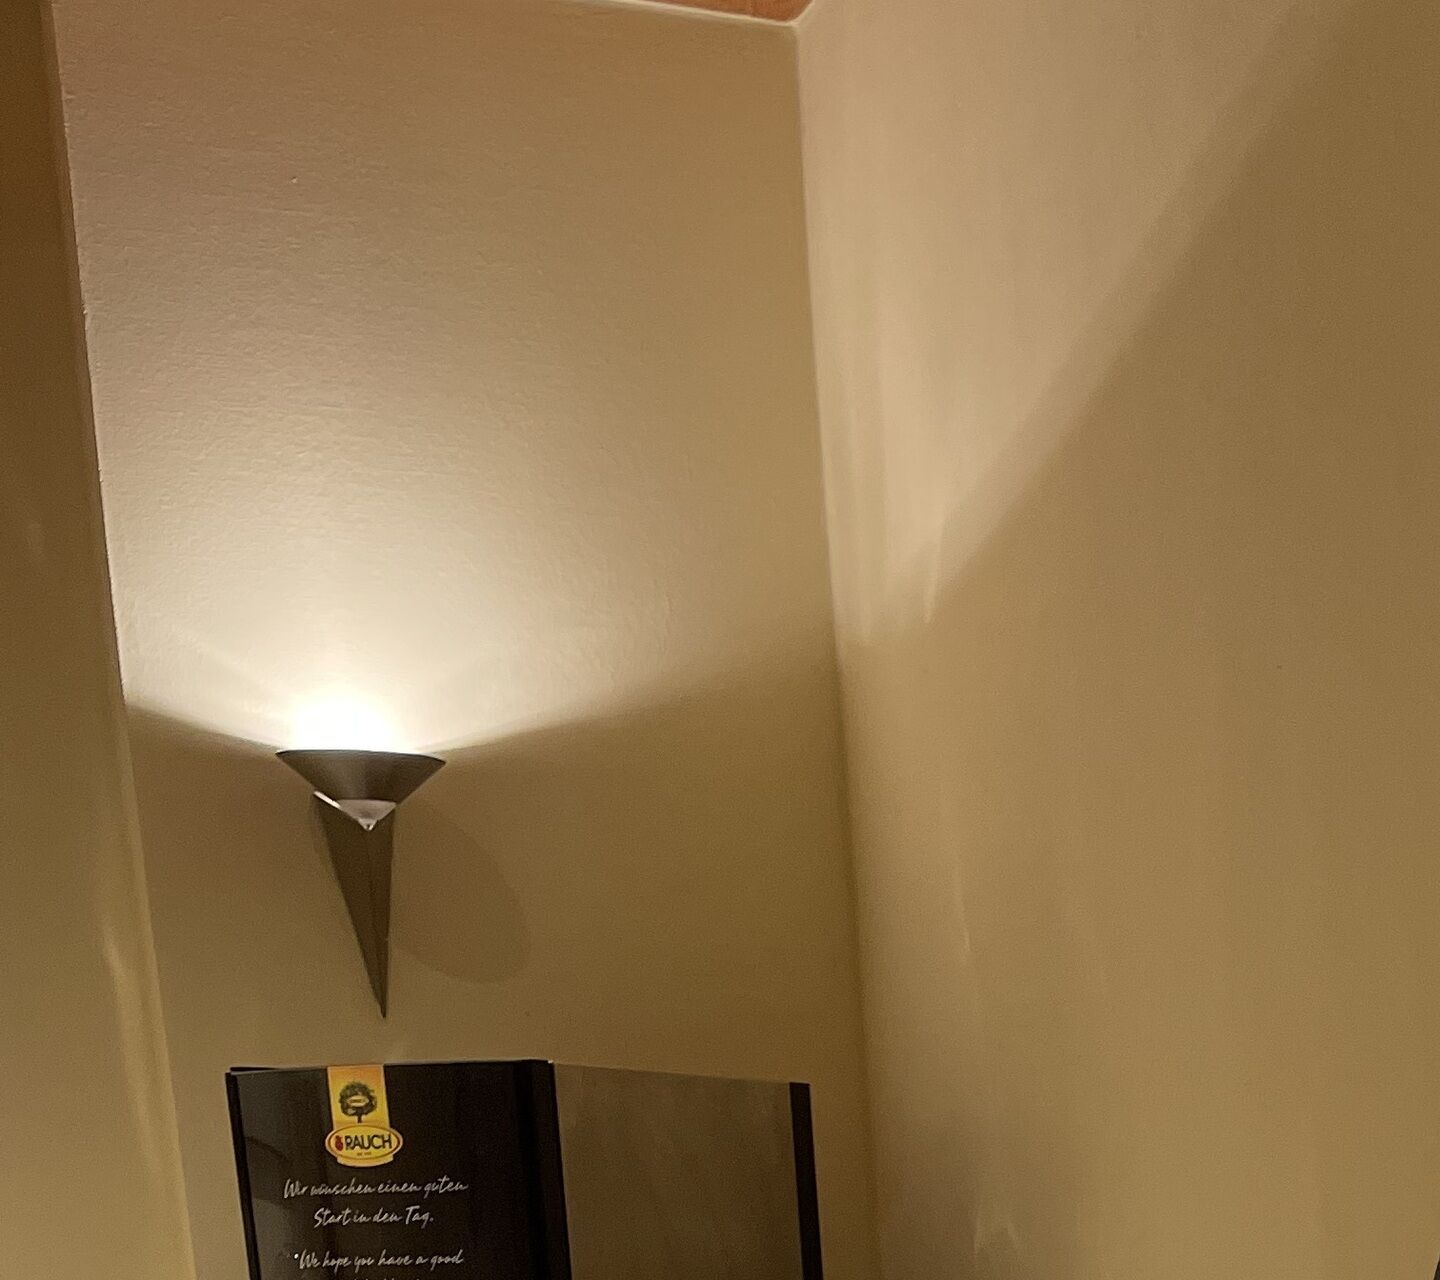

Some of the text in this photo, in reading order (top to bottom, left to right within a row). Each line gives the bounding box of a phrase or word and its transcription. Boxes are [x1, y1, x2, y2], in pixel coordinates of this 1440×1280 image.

[345, 1134, 392, 1150] RAUCH
[284, 1175, 469, 1198] Wir wünschen einen guten
[314, 1205, 434, 1228] Start in den Tag.
[323, 1251, 351, 1274] hope
[354, 1256, 374, 1273] you
[378, 1249, 413, 1266] have
[416, 1255, 428, 1265] a
[430, 1249, 465, 1270] good
